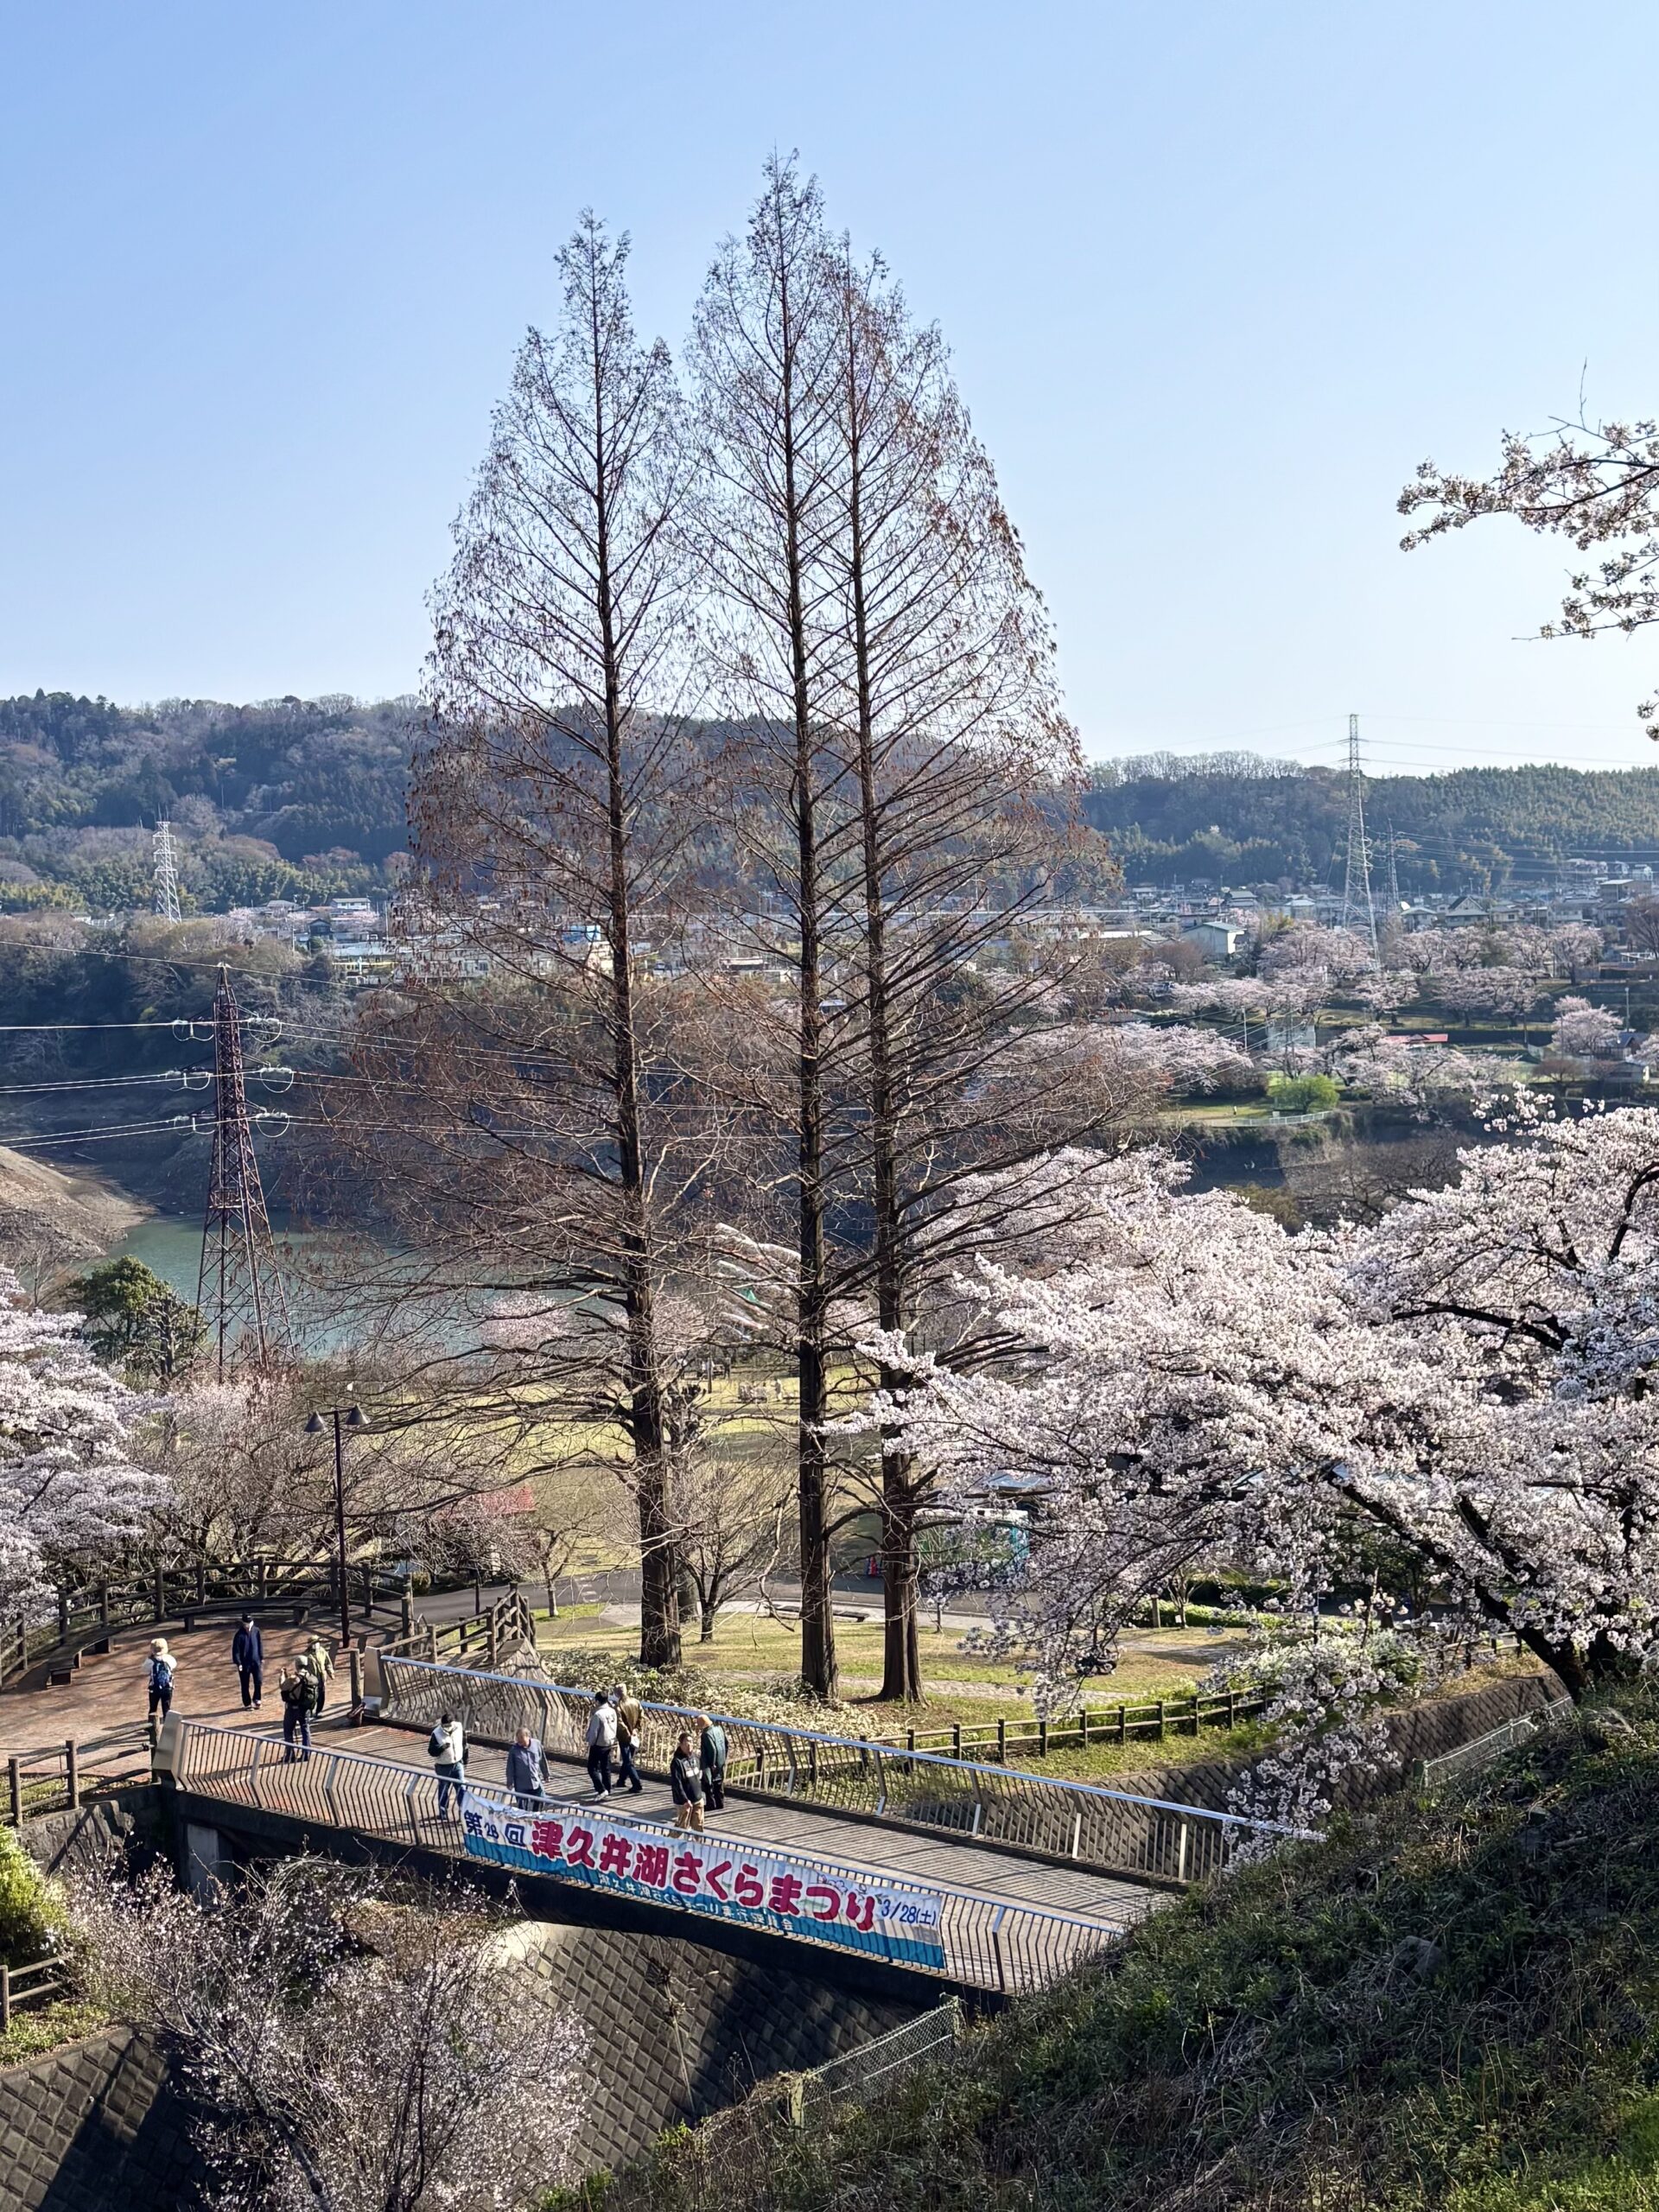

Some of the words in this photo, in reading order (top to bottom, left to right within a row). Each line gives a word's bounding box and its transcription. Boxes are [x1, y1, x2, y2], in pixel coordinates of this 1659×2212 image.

[531, 1821, 875, 1931] 津久井湖さくらまつり
[880, 1898, 937, 1926] 3/28(土)
